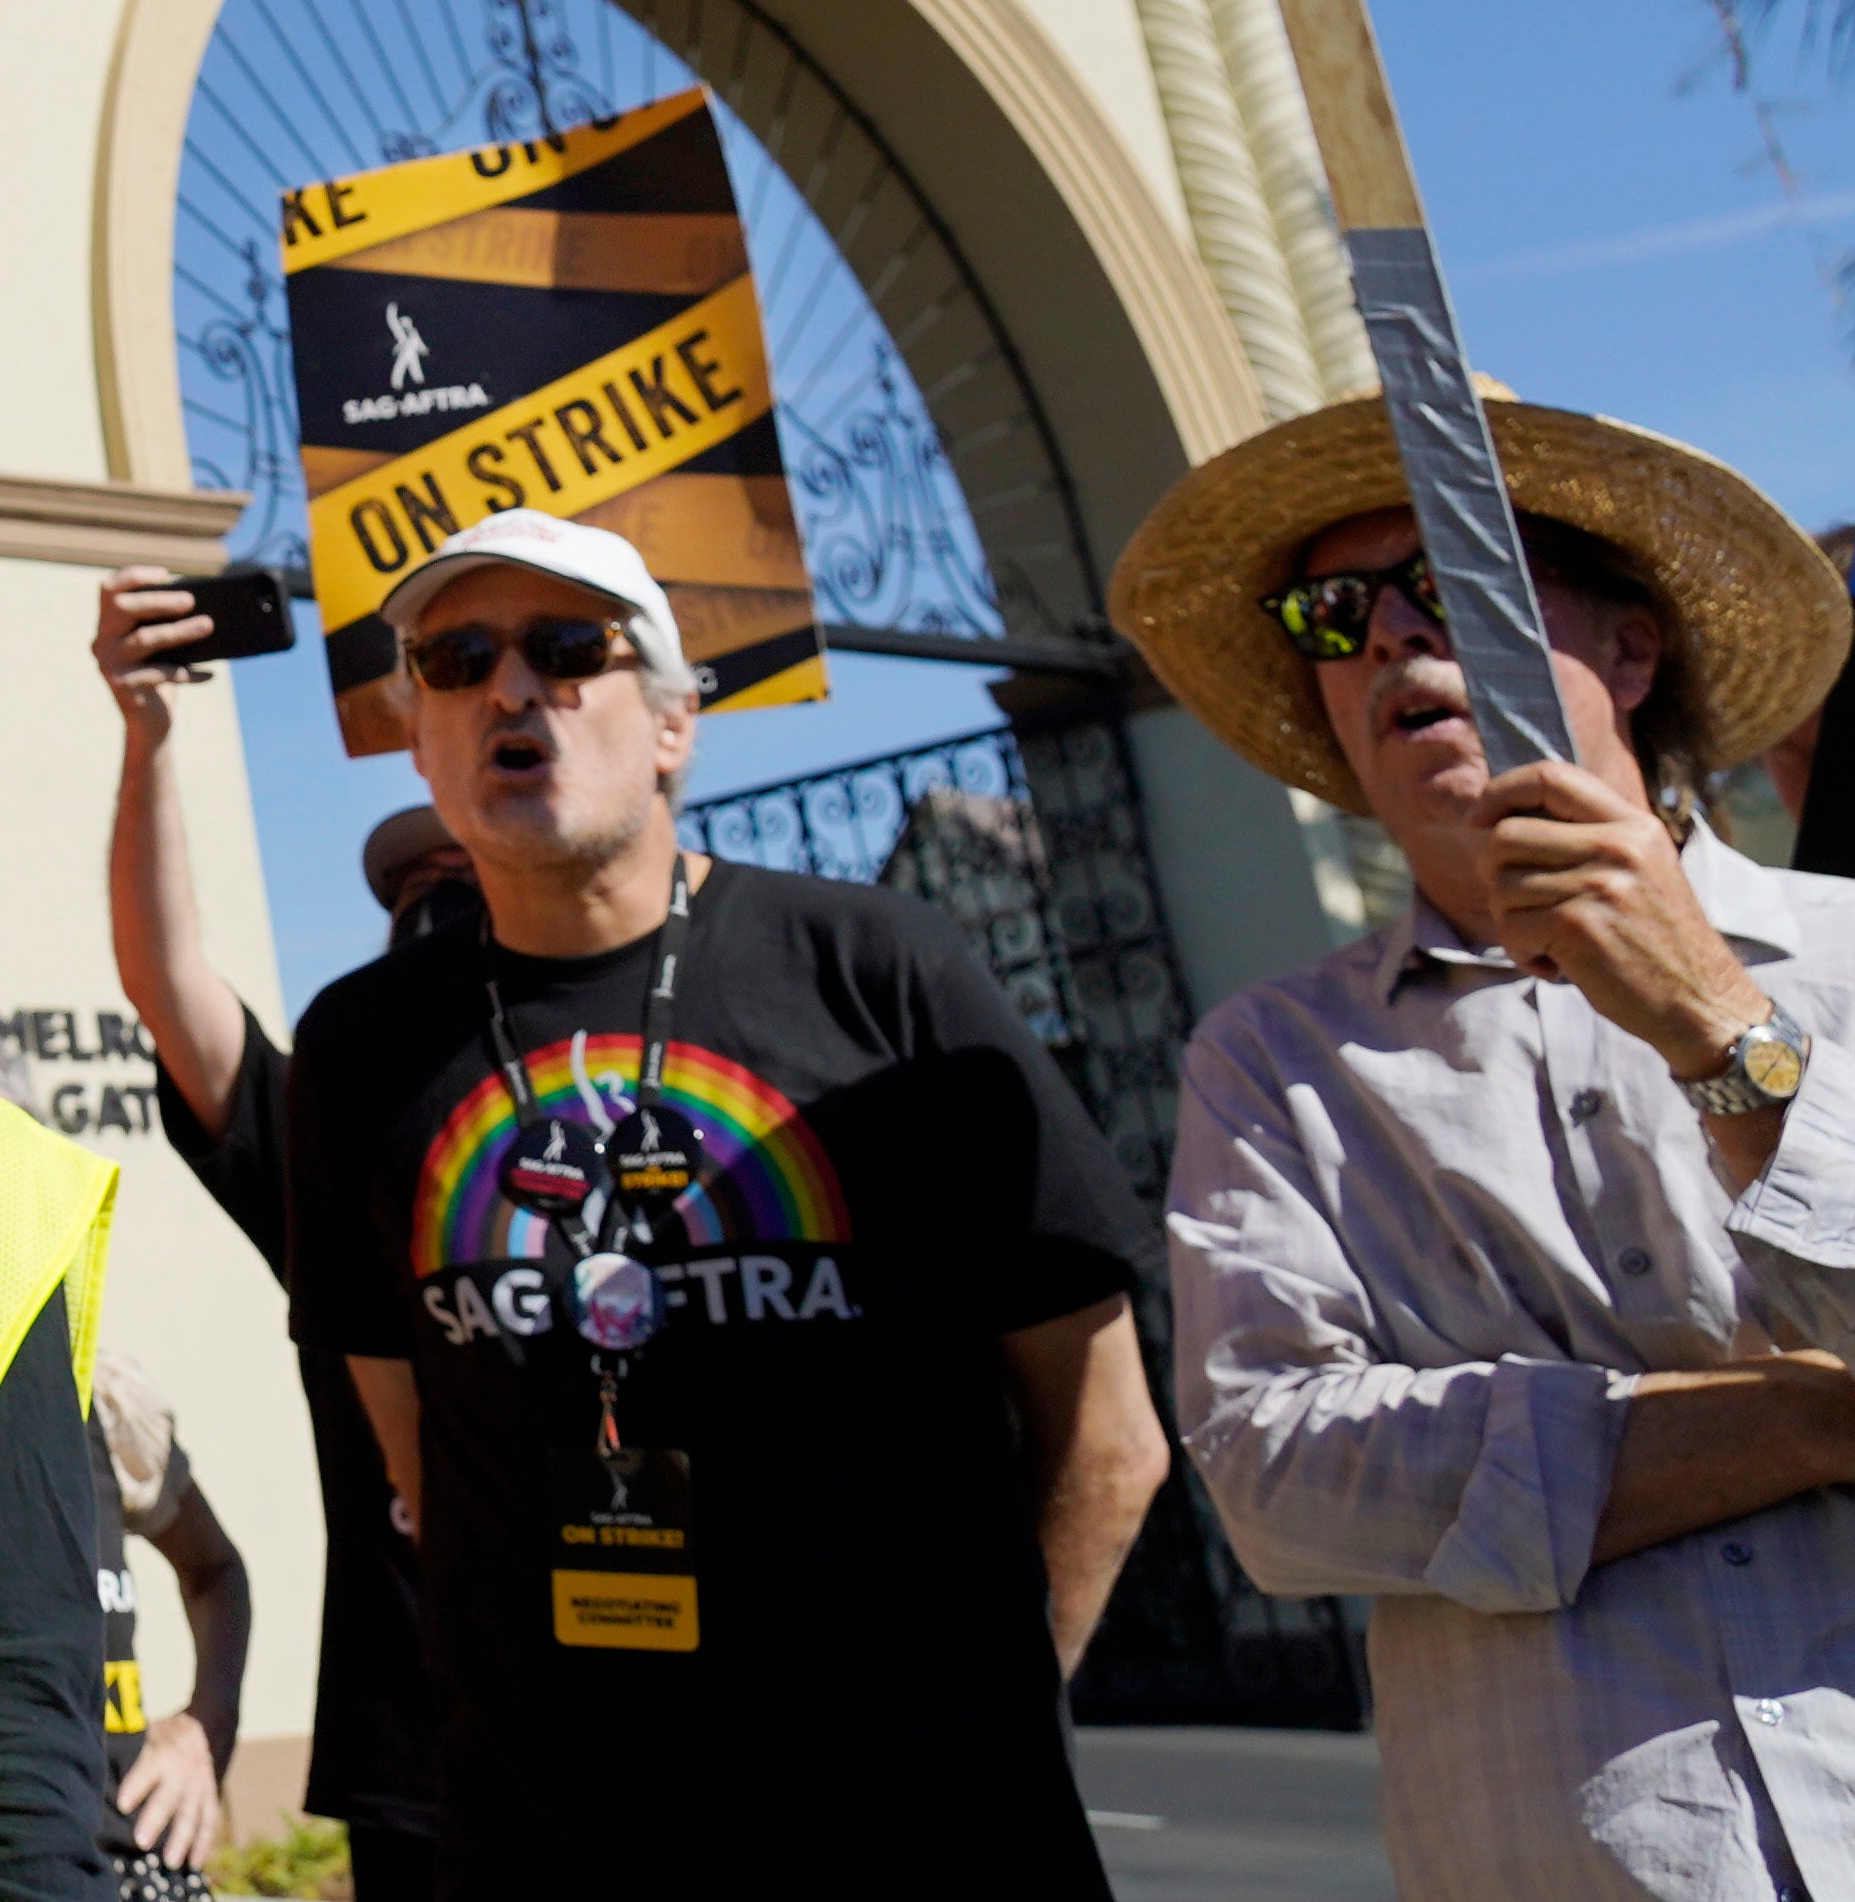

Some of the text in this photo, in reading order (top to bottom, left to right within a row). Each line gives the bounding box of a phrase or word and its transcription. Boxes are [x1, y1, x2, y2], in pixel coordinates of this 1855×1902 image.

[350, 329, 744, 573] ON STRIKE
[53, 1084, 157, 1134] GAT
